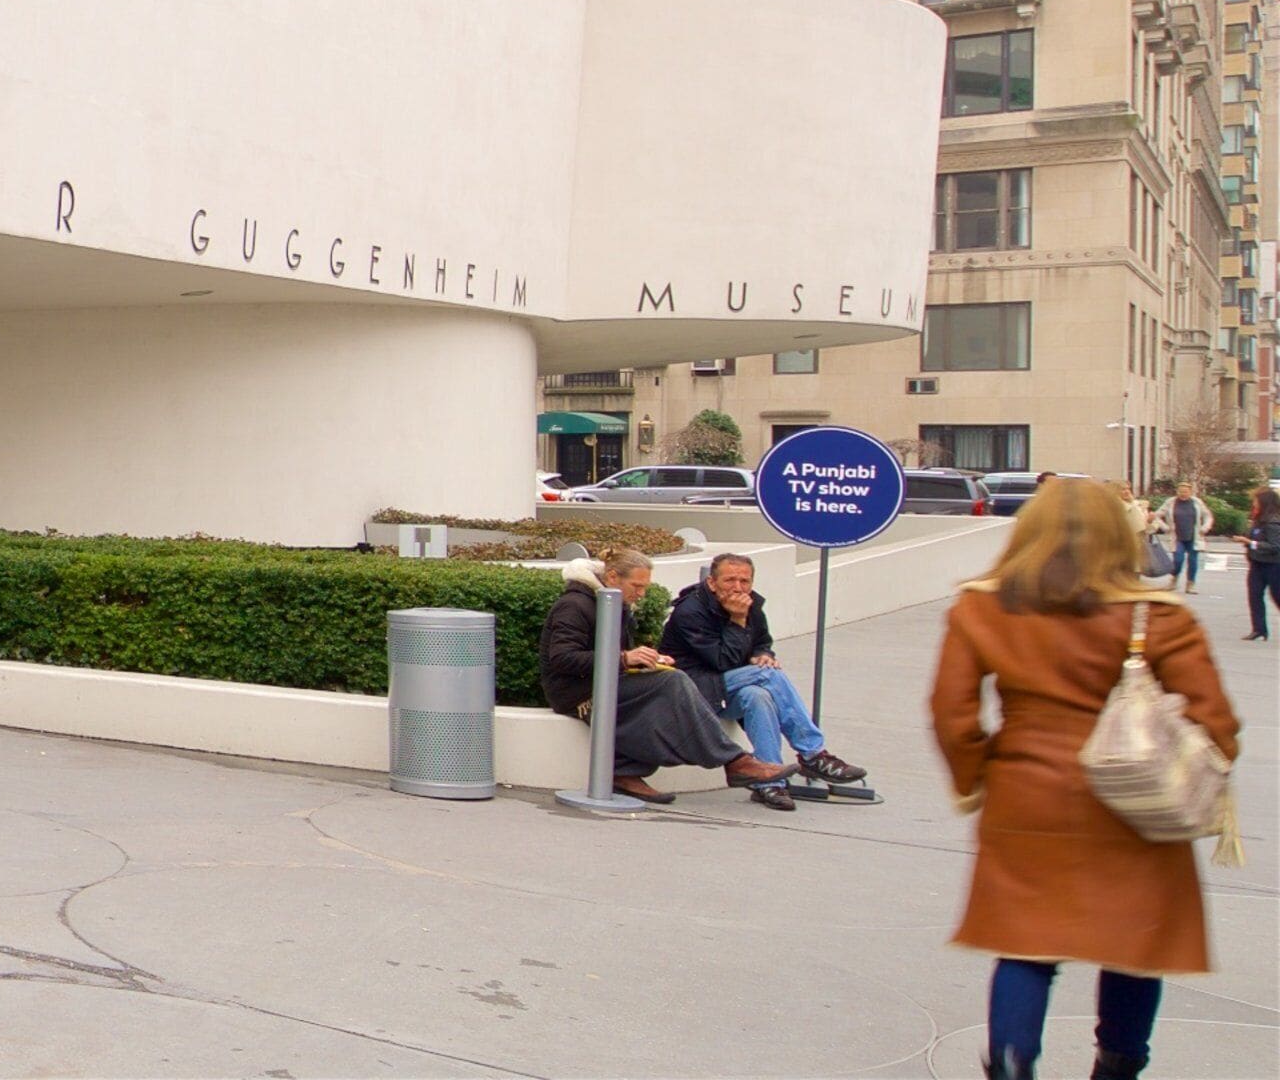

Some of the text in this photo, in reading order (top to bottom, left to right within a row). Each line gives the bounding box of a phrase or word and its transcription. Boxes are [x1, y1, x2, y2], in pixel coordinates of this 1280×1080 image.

[55, 179, 76, 233] R
[189, 207, 528, 308] GUGGENHEIM
[637, 281, 917, 322] MUSEUM
[782, 463, 876, 481] A Punjabi
[789, 480, 869, 496] TV show
[795, 498, 862, 514] is here.
